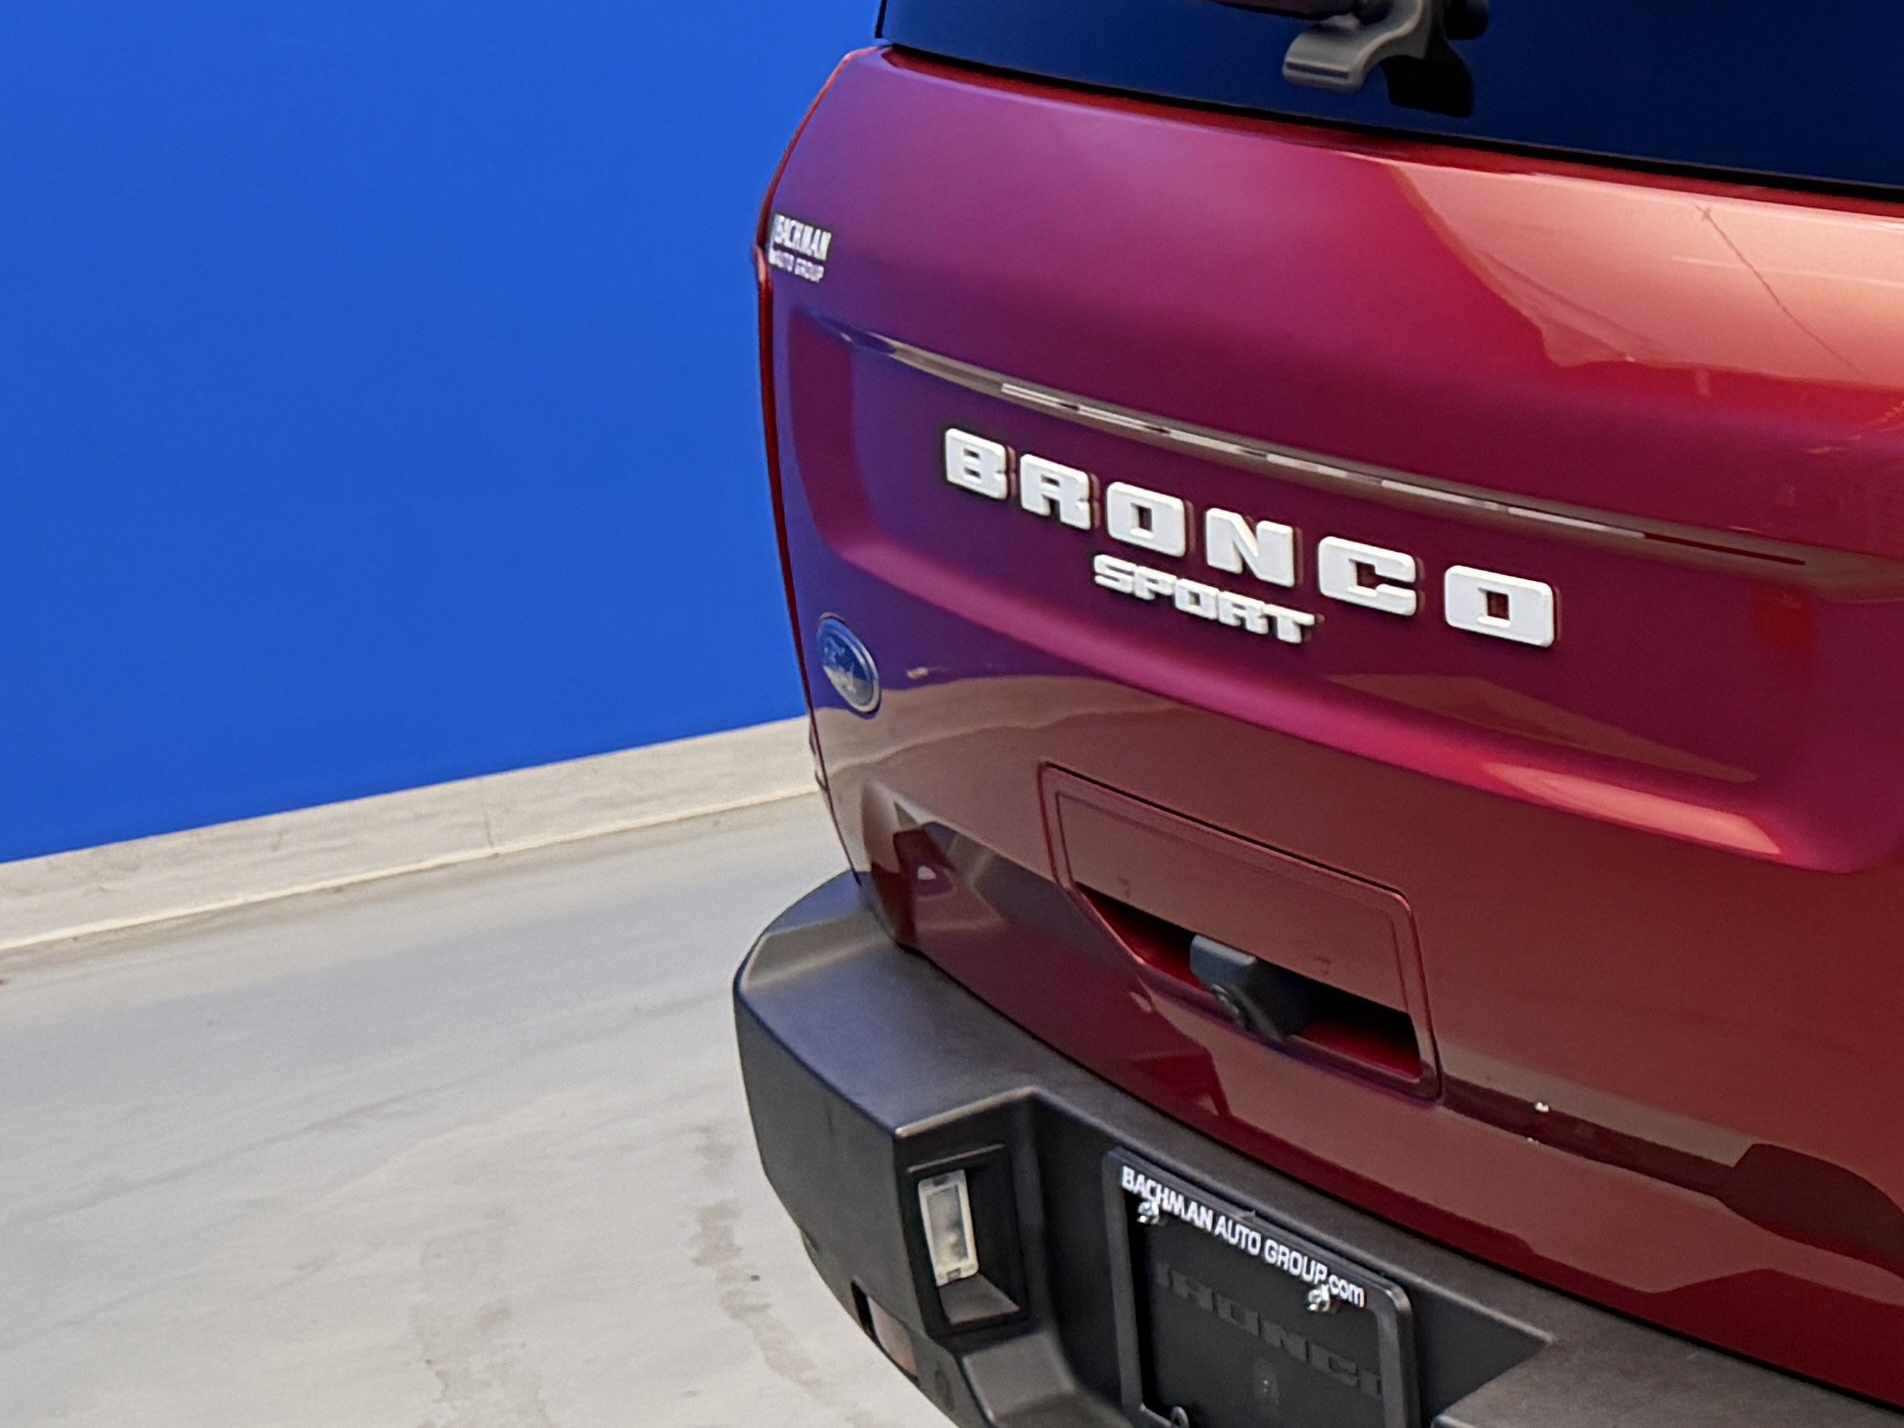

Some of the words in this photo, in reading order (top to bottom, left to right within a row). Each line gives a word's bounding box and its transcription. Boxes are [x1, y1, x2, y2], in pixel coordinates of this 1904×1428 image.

[943, 426, 1556, 649] BRONCO
[1092, 553, 1318, 645] SPORT
[1121, 1166, 1213, 1231] BACHMAN
[1213, 1215, 1262, 1257] AUTO
[1263, 1238, 1366, 1309] GROUP.com
